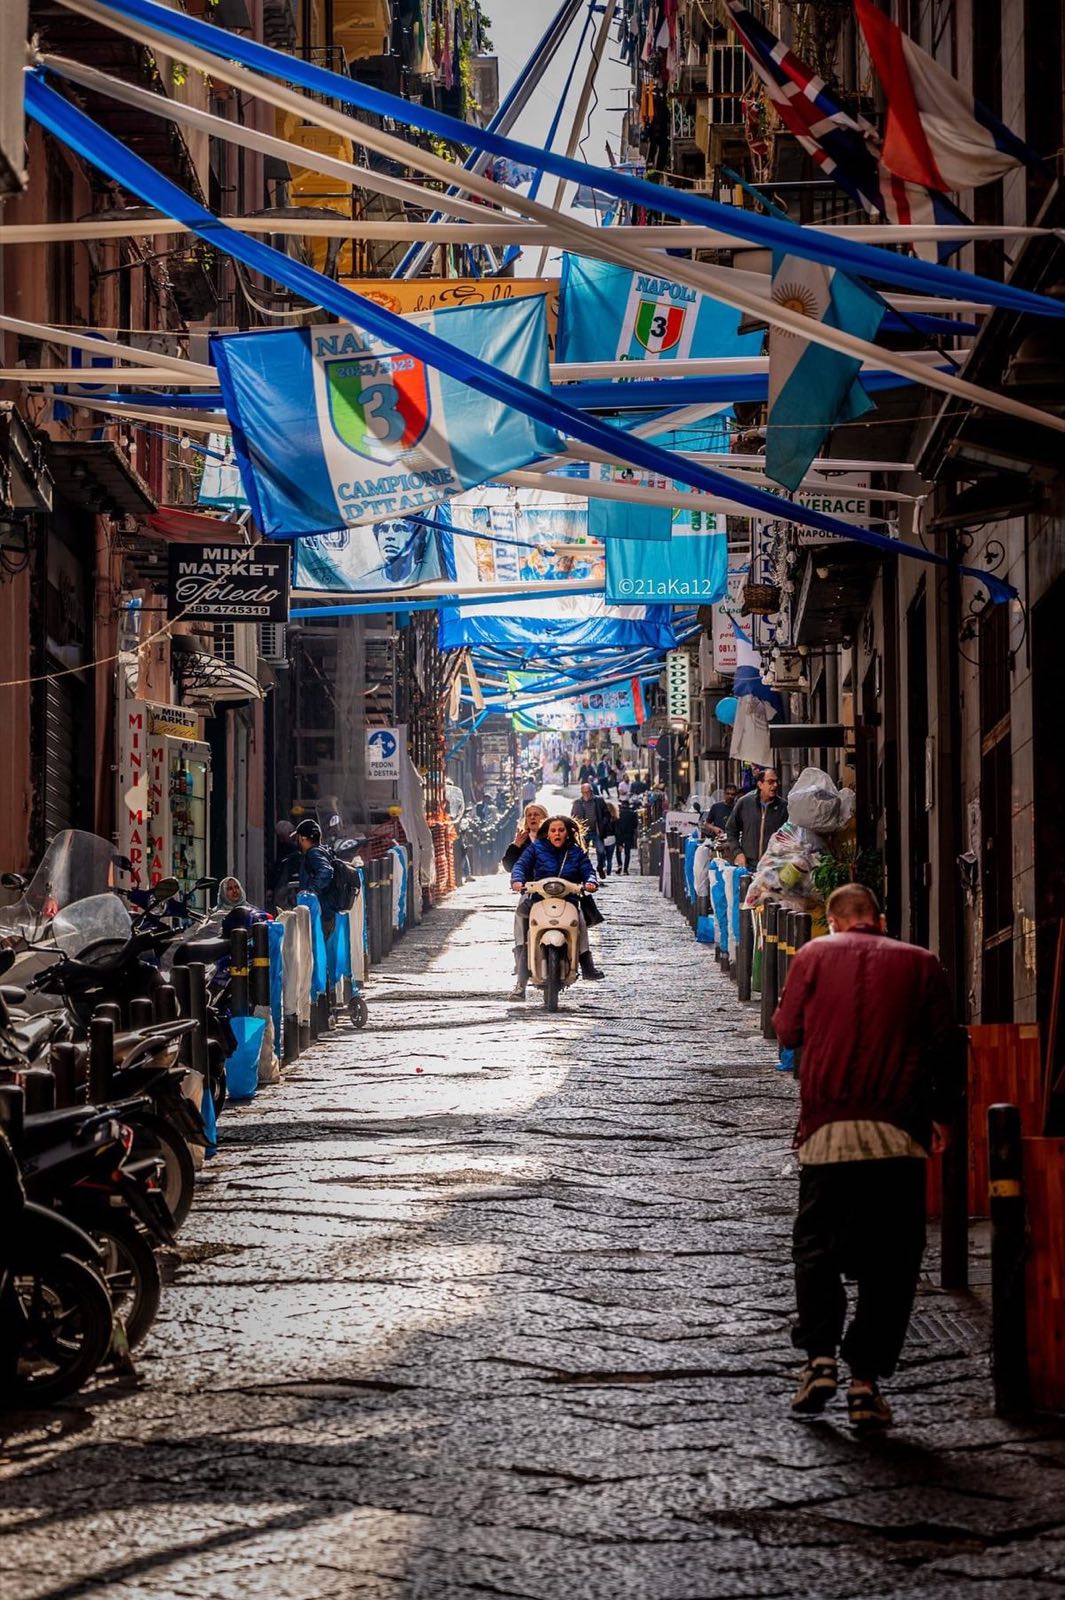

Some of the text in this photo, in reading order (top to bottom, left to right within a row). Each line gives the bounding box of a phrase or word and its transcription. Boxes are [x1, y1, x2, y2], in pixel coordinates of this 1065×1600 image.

[636, 276, 697, 303] NAPOLI
[650, 316, 667, 338] 3
[358, 383, 407, 444] 3
[337, 467, 456, 501] CAMPIONE
[800, 499, 866, 514] VERACE
[202, 547, 255, 561] MINI
[178, 562, 280, 577] MARKET
[175, 575, 281, 603] Toledo
[213, 605, 268, 616] 4745319
[669, 655, 688, 716] PODOLOGO
[152, 712, 196, 728] MARKET
[161, 708, 187, 719] MINI
[128, 713, 143, 787] MINI
[151, 747, 164, 816] MINI
